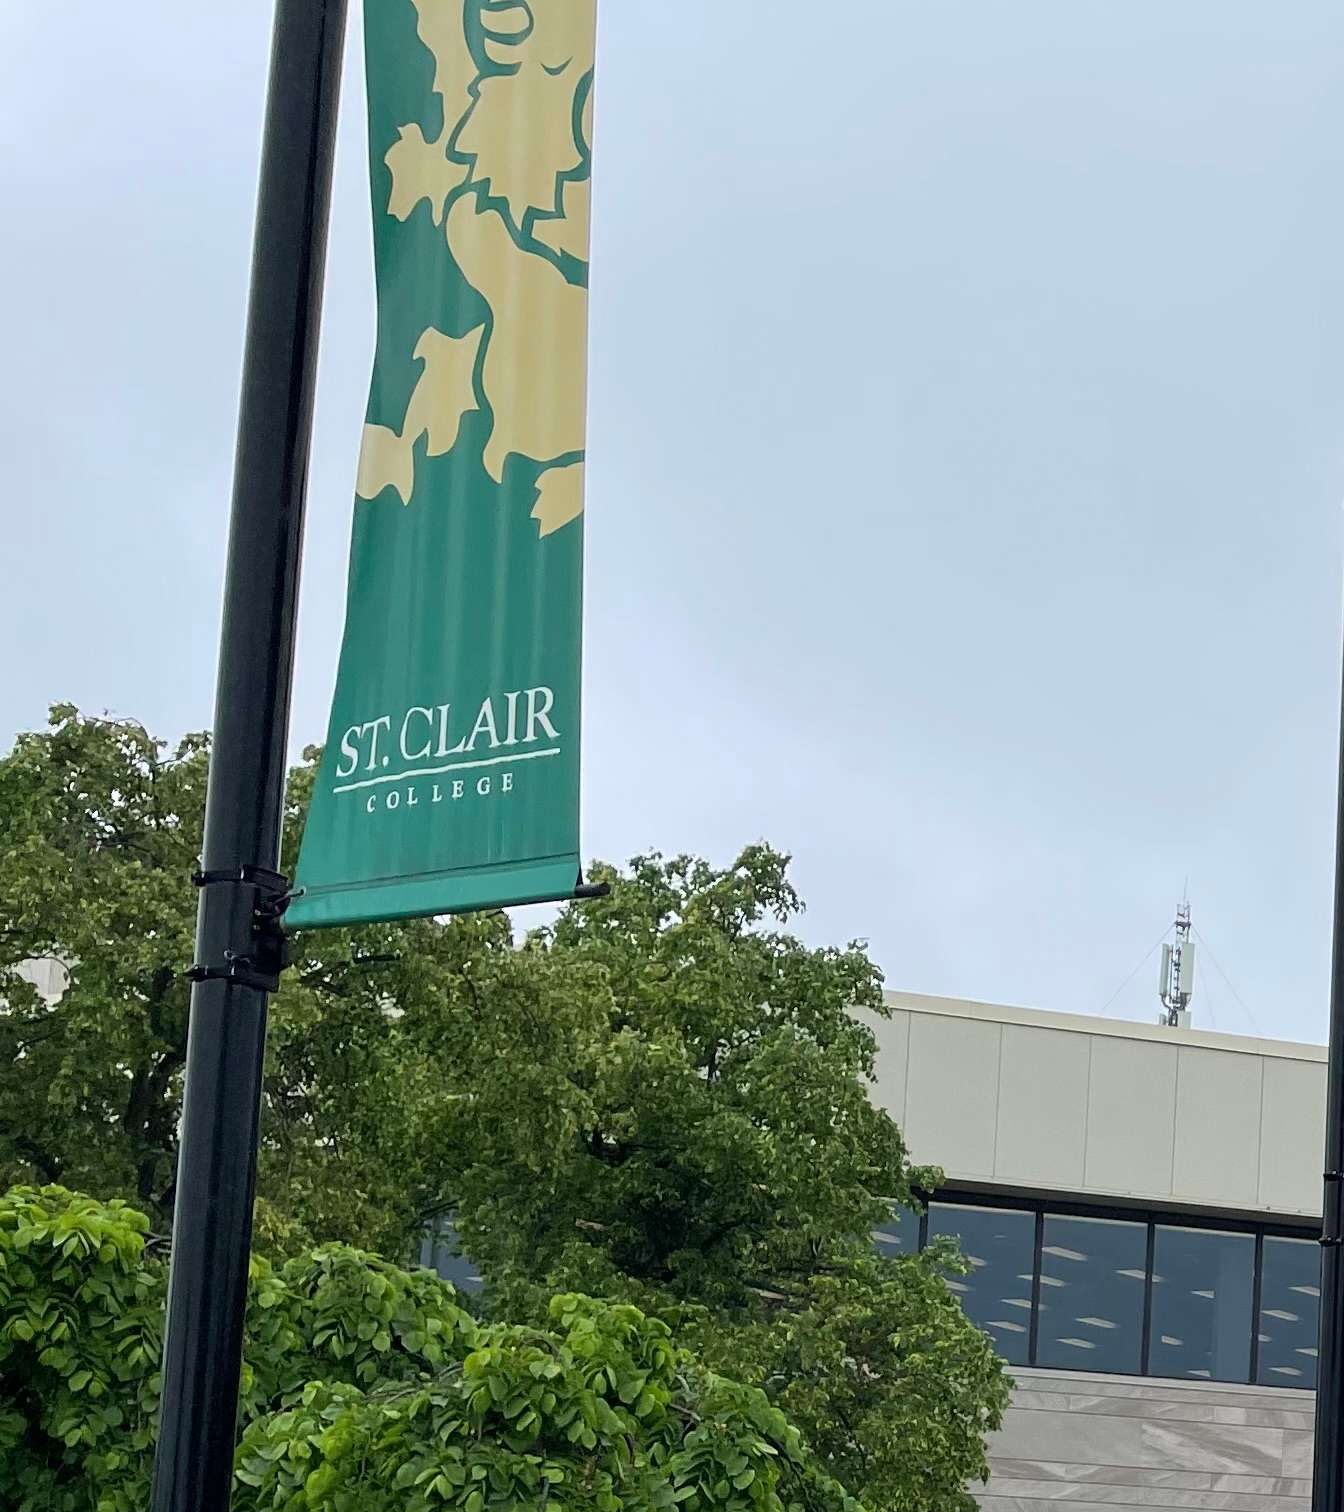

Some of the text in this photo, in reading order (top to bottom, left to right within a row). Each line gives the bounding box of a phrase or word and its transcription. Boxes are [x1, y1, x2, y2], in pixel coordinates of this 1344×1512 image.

[336, 686, 560, 777] ST. CLAIR
[366, 773, 514, 812] COLLEGE
